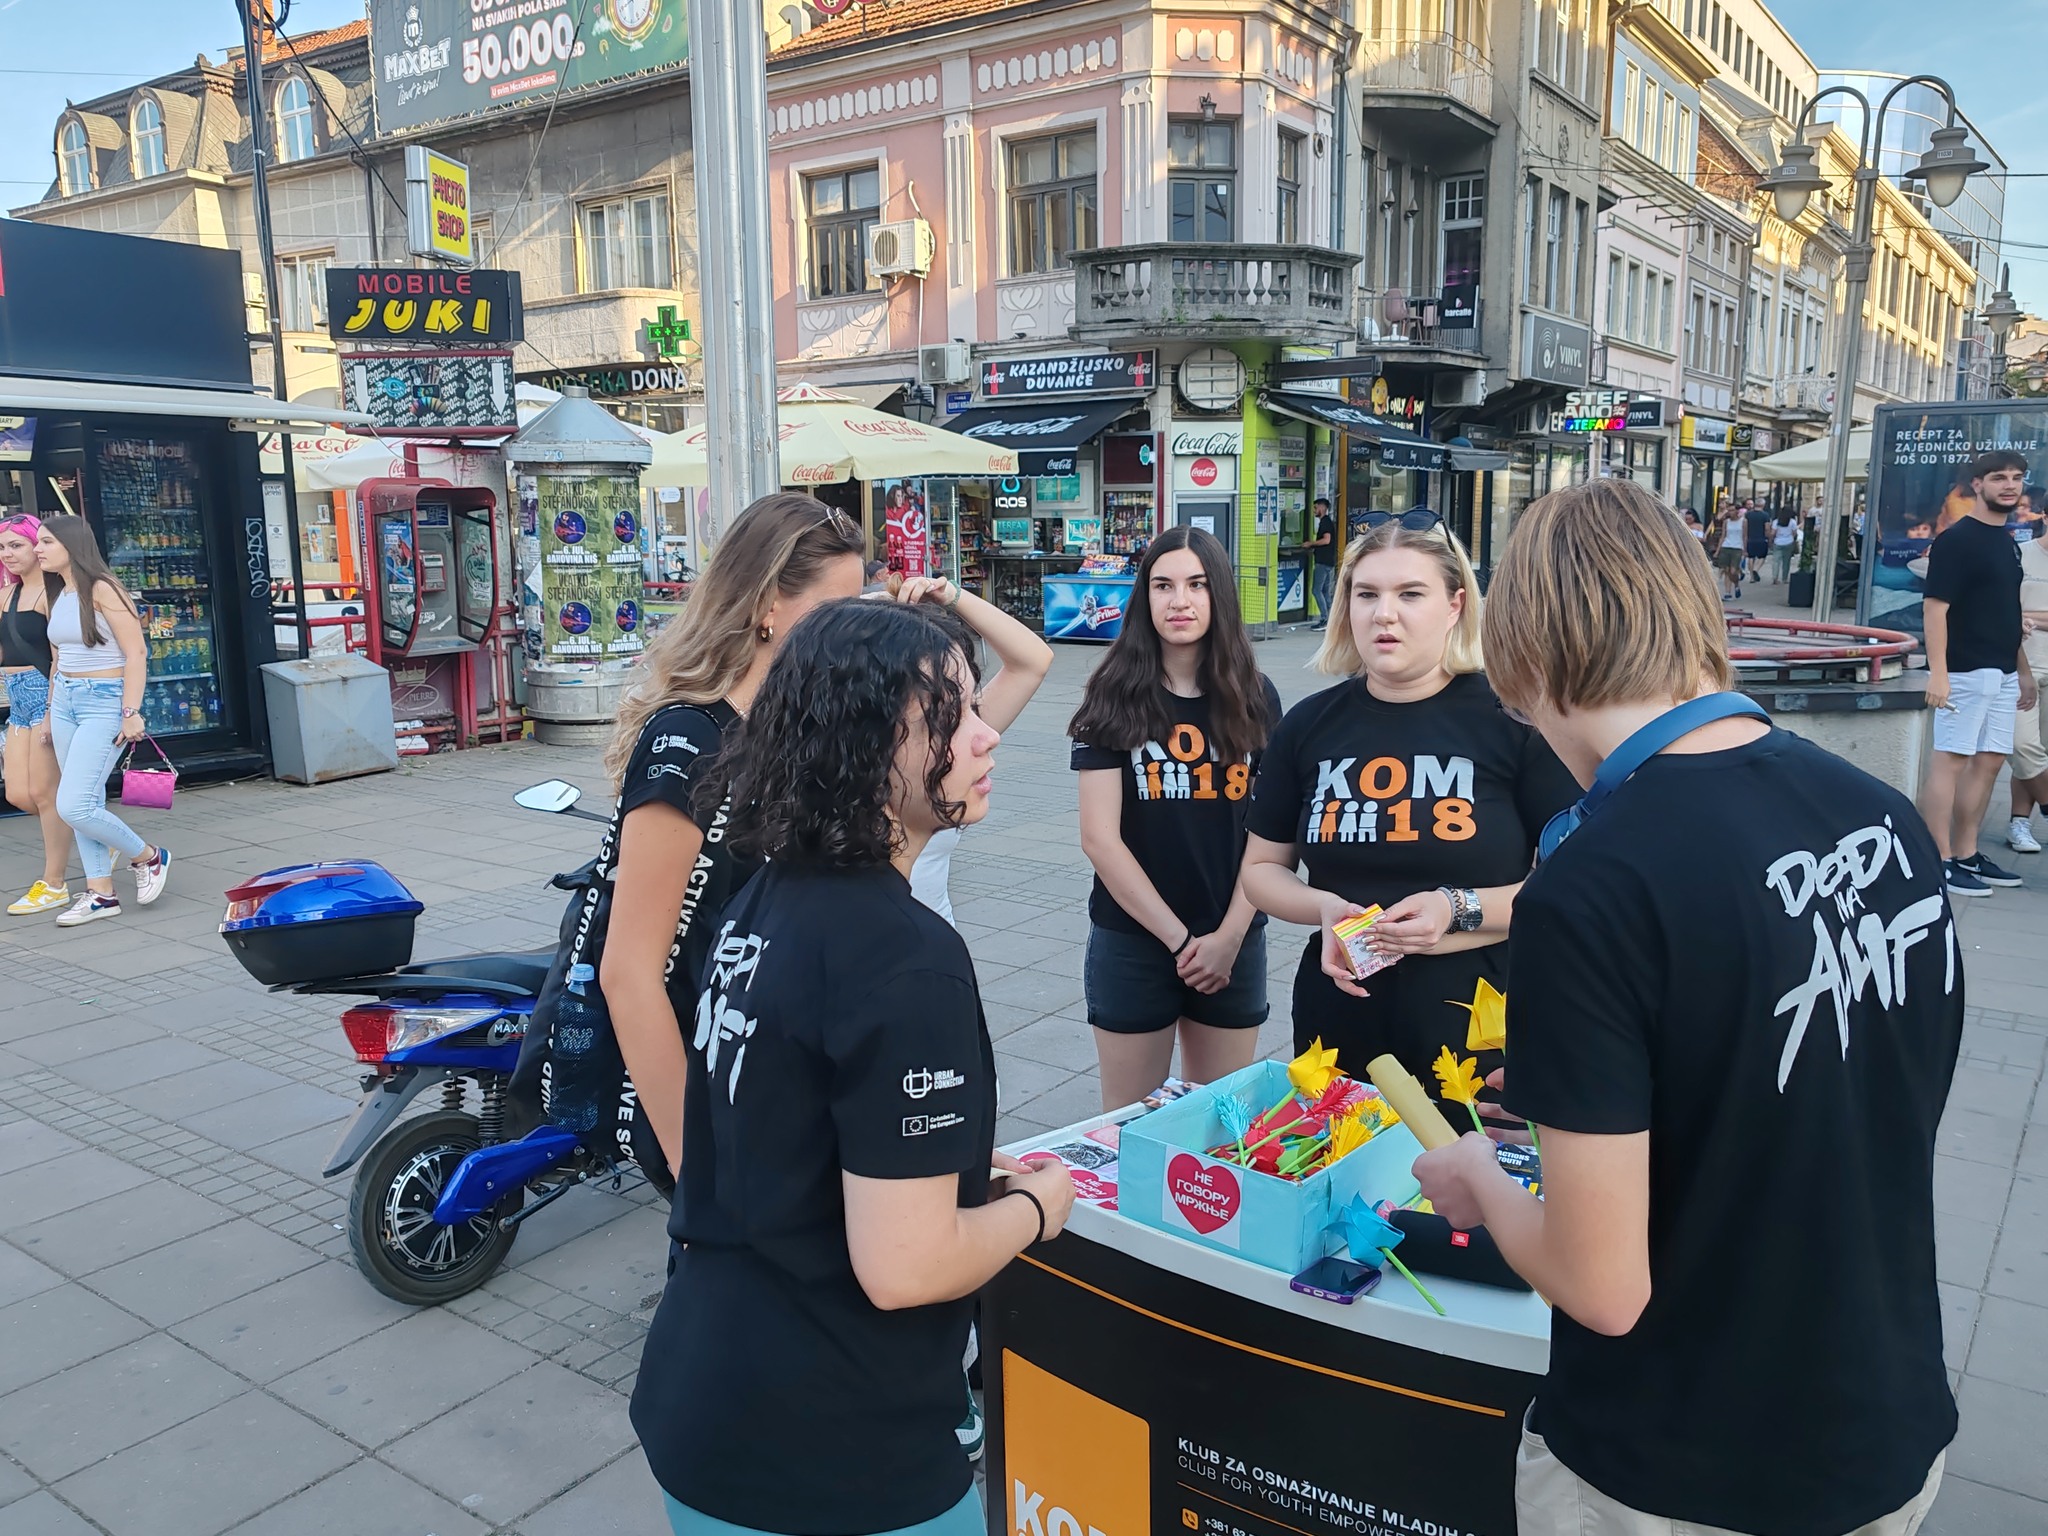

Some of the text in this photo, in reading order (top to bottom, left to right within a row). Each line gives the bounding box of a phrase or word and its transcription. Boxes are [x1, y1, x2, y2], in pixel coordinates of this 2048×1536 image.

[472, 17, 485, 31] NA
[485, 7, 517, 28] SVAKIH
[517, 2, 543, 18] POLA
[462, 13, 574, 84] 50.000
[431, 172, 466, 210] PHOTO
[437, 209, 465, 242] SHOP
[358, 274, 472, 294] MOBILE
[344, 298, 491, 335] JUKI
[1559, 344, 1582, 368] VINYL
[1009, 357, 1125, 378] KAZANDŽIJSKO
[631, 367, 690, 392] DONA
[1025, 371, 1095, 391] DUVANČE
[1405, 395, 1415, 419] 4
[1566, 391, 1629, 405] STEF
[1565, 405, 1612, 418] ANO
[1565, 418, 1625, 431] STEFANO
[1896, 430, 1963, 441] RECEPT ZA
[1172, 432, 1241, 455] Coca-Cola
[1895, 438, 2038, 453] ZAJEDNIČKO UŽIVANJE
[1894, 453, 1916, 465] JOŠ
[1920, 454, 1937, 464] OD
[1942, 453, 1973, 464] 1877.
[792, 464, 838, 482] Coca-Cola
[995, 496, 1027, 508] IQOS
[547, 554, 583, 564] BANOVINA
[572, 546, 585, 555] JUL
[579, 635, 591, 645] JUL
[1193, 763, 1249, 801] 18
[1311, 755, 1475, 804] KOM
[1386, 798, 1477, 842] 18
[676, 852, 714, 938] ACTIVE
[571, 887, 599, 966] SQUAD
[494, 1023, 518, 1033] MAX
[934, 1069, 954, 1081] URBAN
[934, 1075, 964, 1089] CONNECTION
[1194, 1171, 1213, 1187] НЕ
[1176, 1178, 1230, 1206] ГОВОРУ
[1174, 1192, 1229, 1221] МРЖЊЕ
[1178, 1455, 1217, 1481] CLUB
[1222, 1473, 1252, 1494] FOR
[1257, 1485, 1313, 1517] YOUTH
[1178, 1437, 1458, 1536] KLUB ZA OSNAŽIVANJE MLADIH
[1014, 1479, 1108, 1536] KO
[1204, 1518, 1229, 1534] +381
